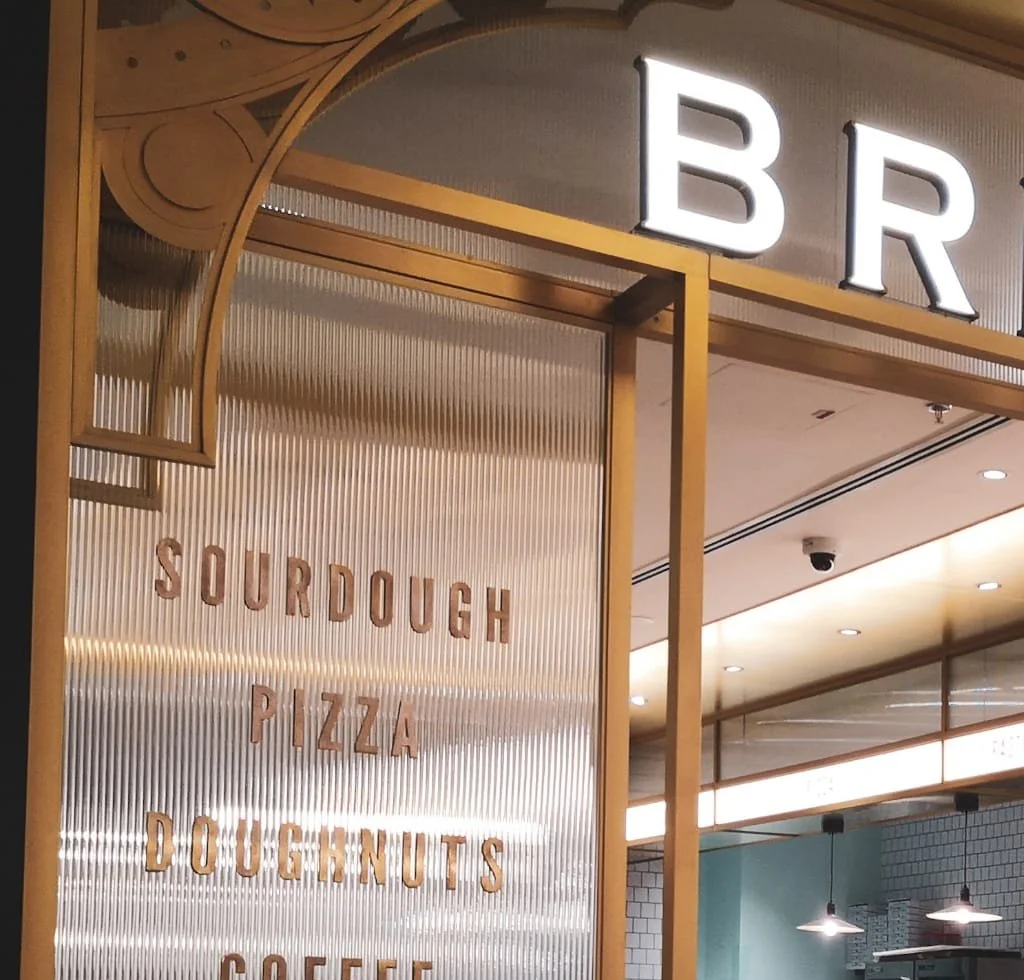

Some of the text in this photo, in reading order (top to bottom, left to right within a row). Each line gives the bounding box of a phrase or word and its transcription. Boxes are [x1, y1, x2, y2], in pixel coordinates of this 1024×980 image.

[155, 537, 511, 644] SOURDOUGH
[251, 684, 419, 759] PIZZA
[145, 811, 505, 894] DOUGHNUTS
